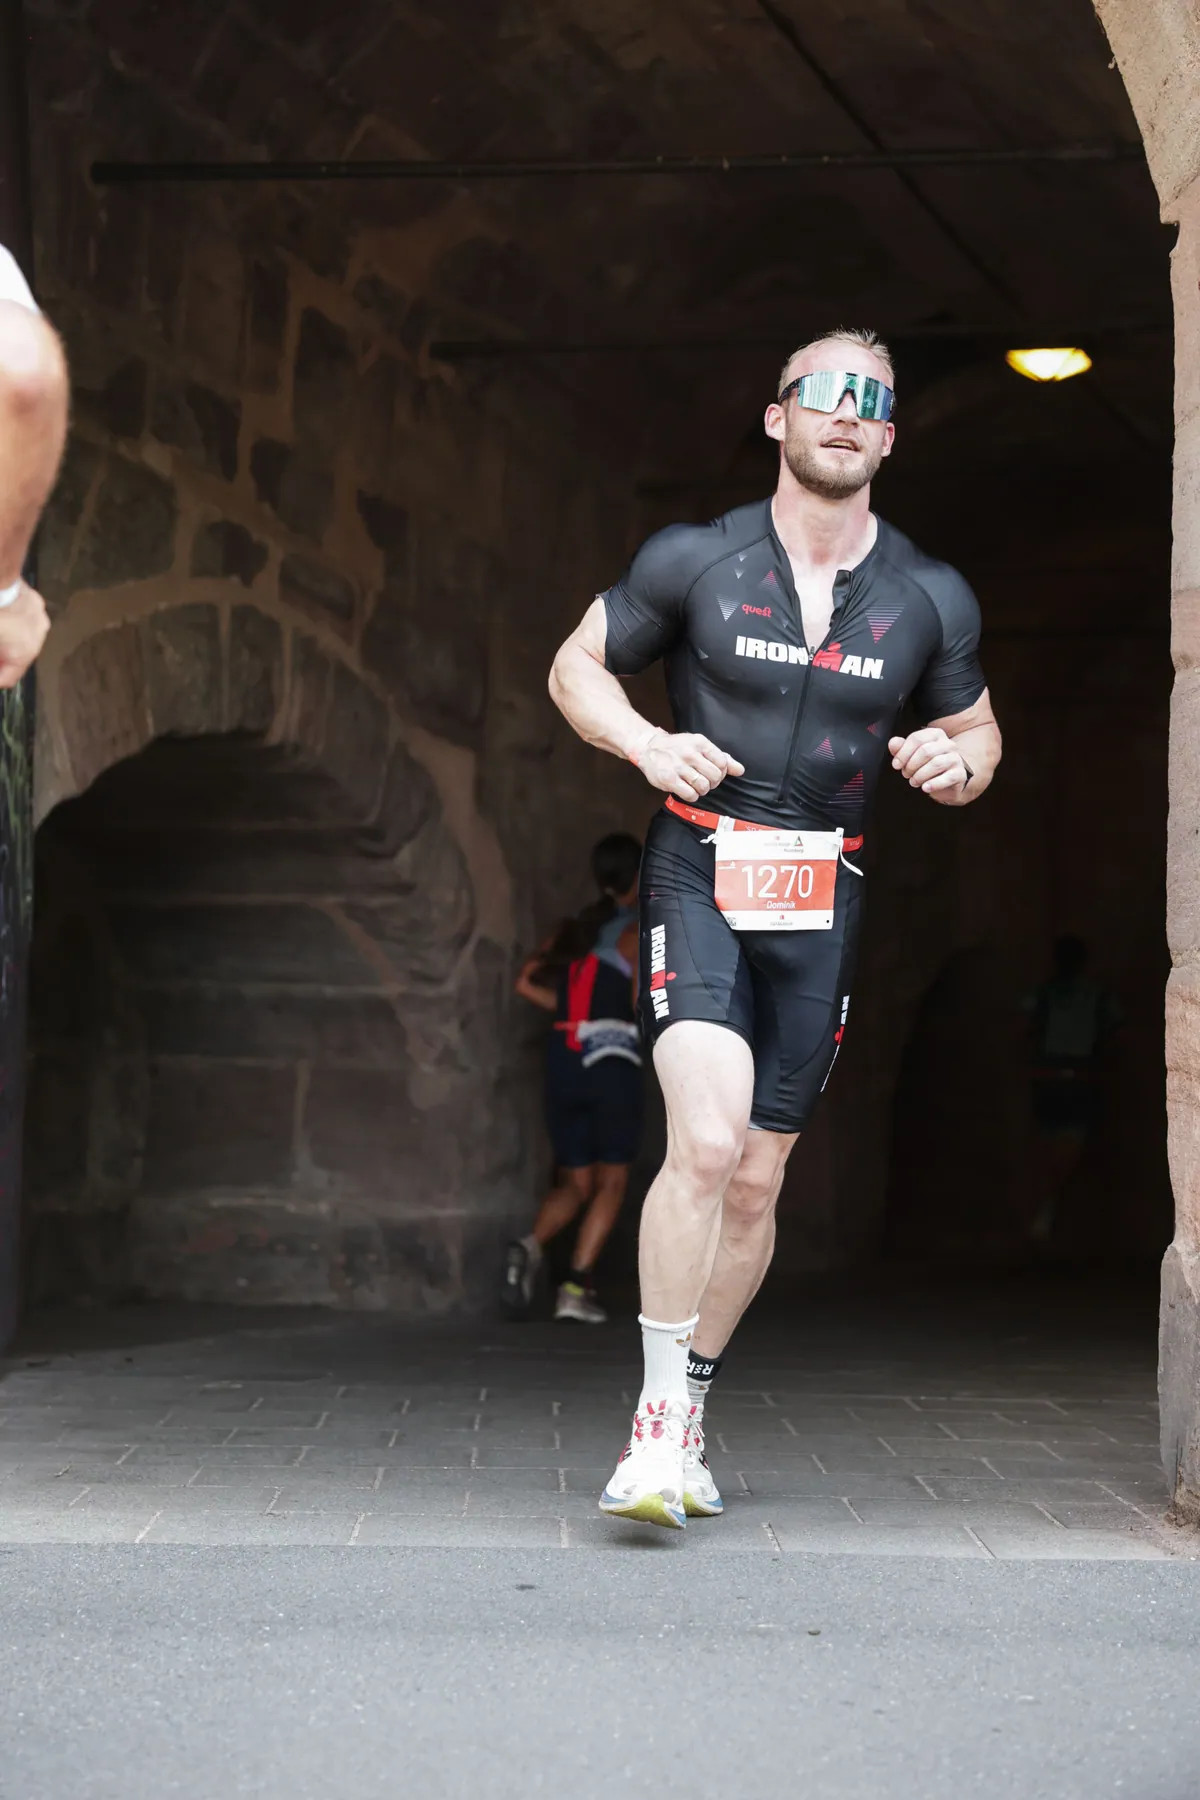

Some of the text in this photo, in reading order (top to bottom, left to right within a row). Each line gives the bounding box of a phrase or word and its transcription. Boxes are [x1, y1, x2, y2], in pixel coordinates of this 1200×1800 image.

[741, 603, 772, 618] quest
[735, 635, 884, 680] IRONMAN
[741, 865, 814, 899] 1270
[766, 900, 796, 909] Dominik
[649, 924, 677, 1020] IRONMAN
